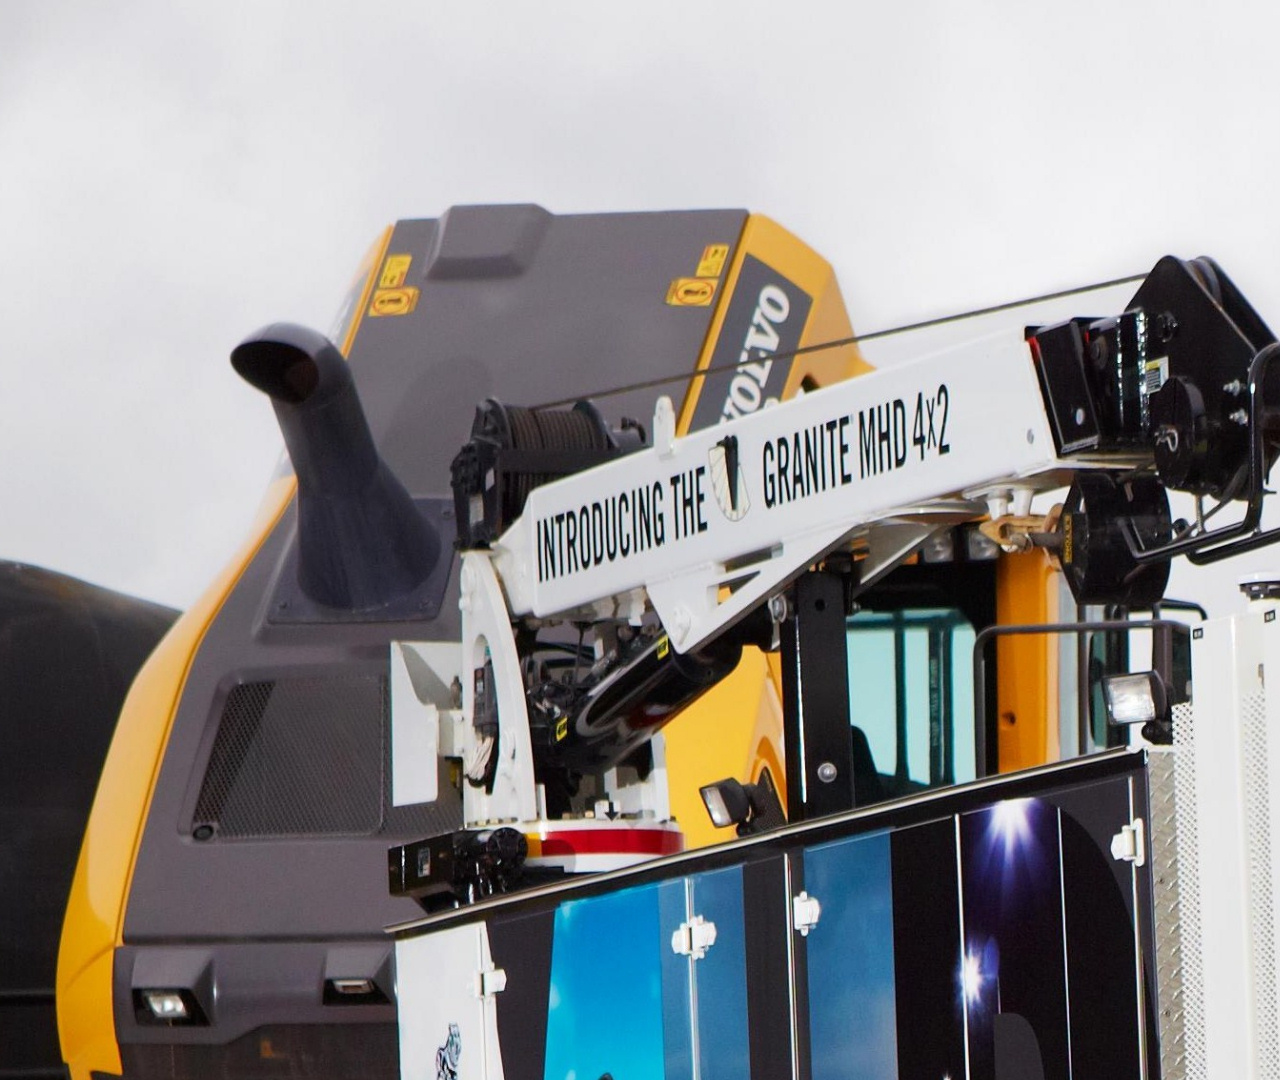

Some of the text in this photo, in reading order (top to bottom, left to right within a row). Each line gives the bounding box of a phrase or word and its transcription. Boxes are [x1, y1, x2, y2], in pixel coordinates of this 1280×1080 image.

[537, 481, 665, 582] INTRODUCING
[670, 466, 708, 540] THE
[763, 415, 852, 509] GRANITE
[859, 399, 907, 479] MHD
